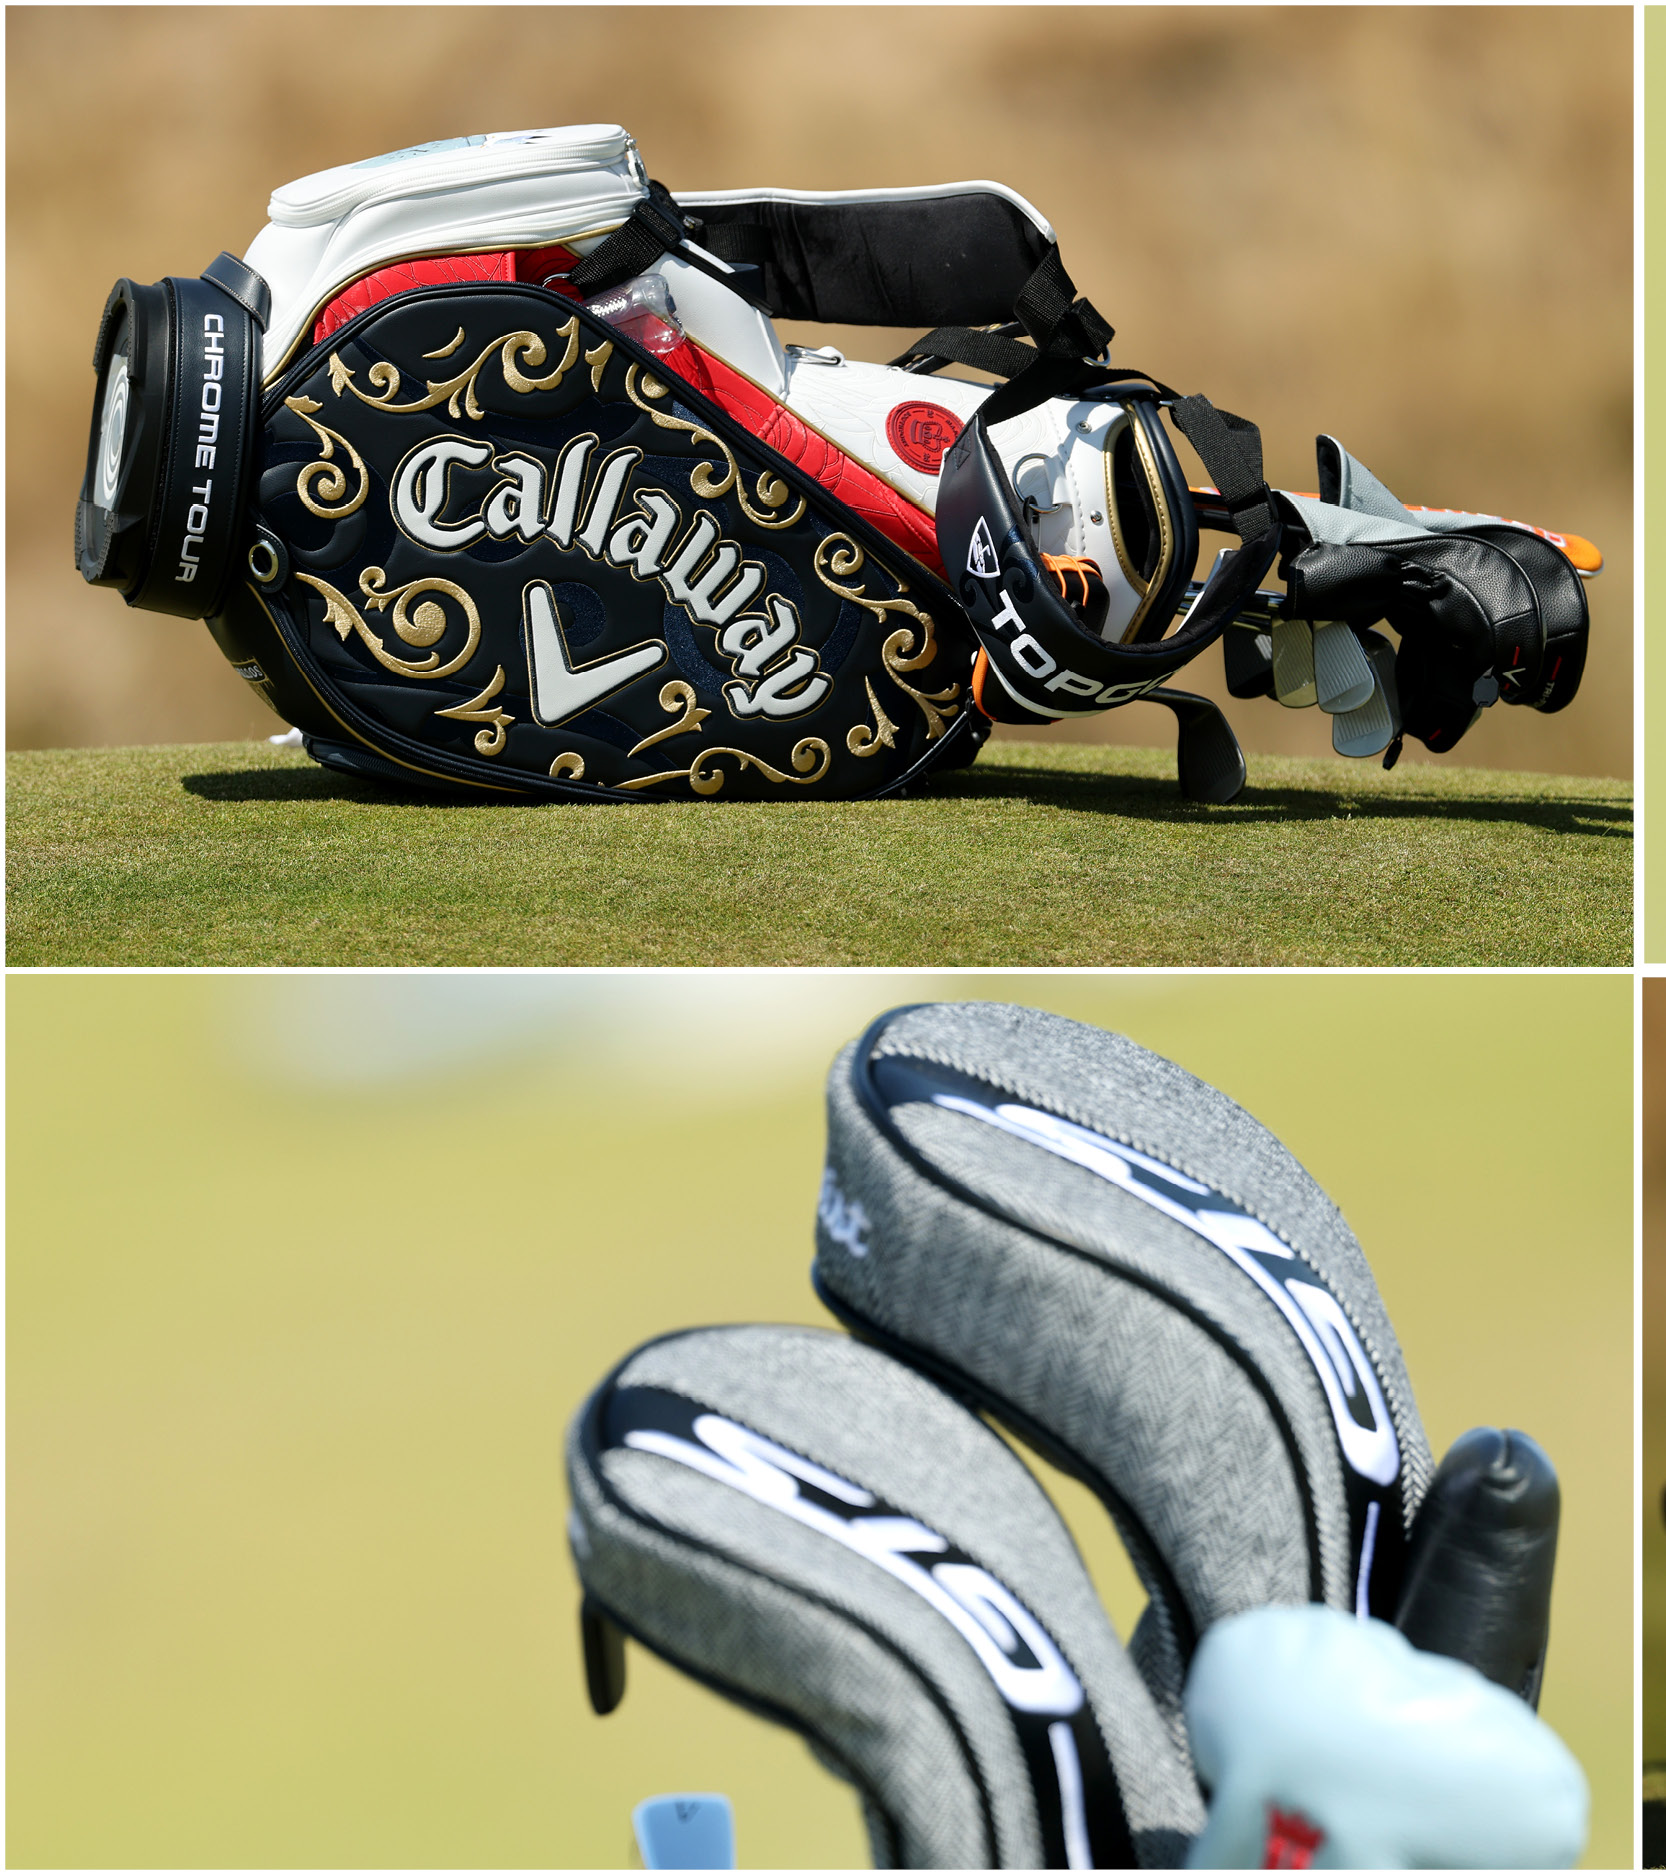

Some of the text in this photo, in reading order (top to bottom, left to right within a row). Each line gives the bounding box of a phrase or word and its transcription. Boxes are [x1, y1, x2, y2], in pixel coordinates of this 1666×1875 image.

[174, 313, 224, 584] CHROME TOUR
[393, 432, 833, 722] Callaway
[930, 1091, 1402, 1487] GTS
[622, 1411, 1085, 1716] GTS
